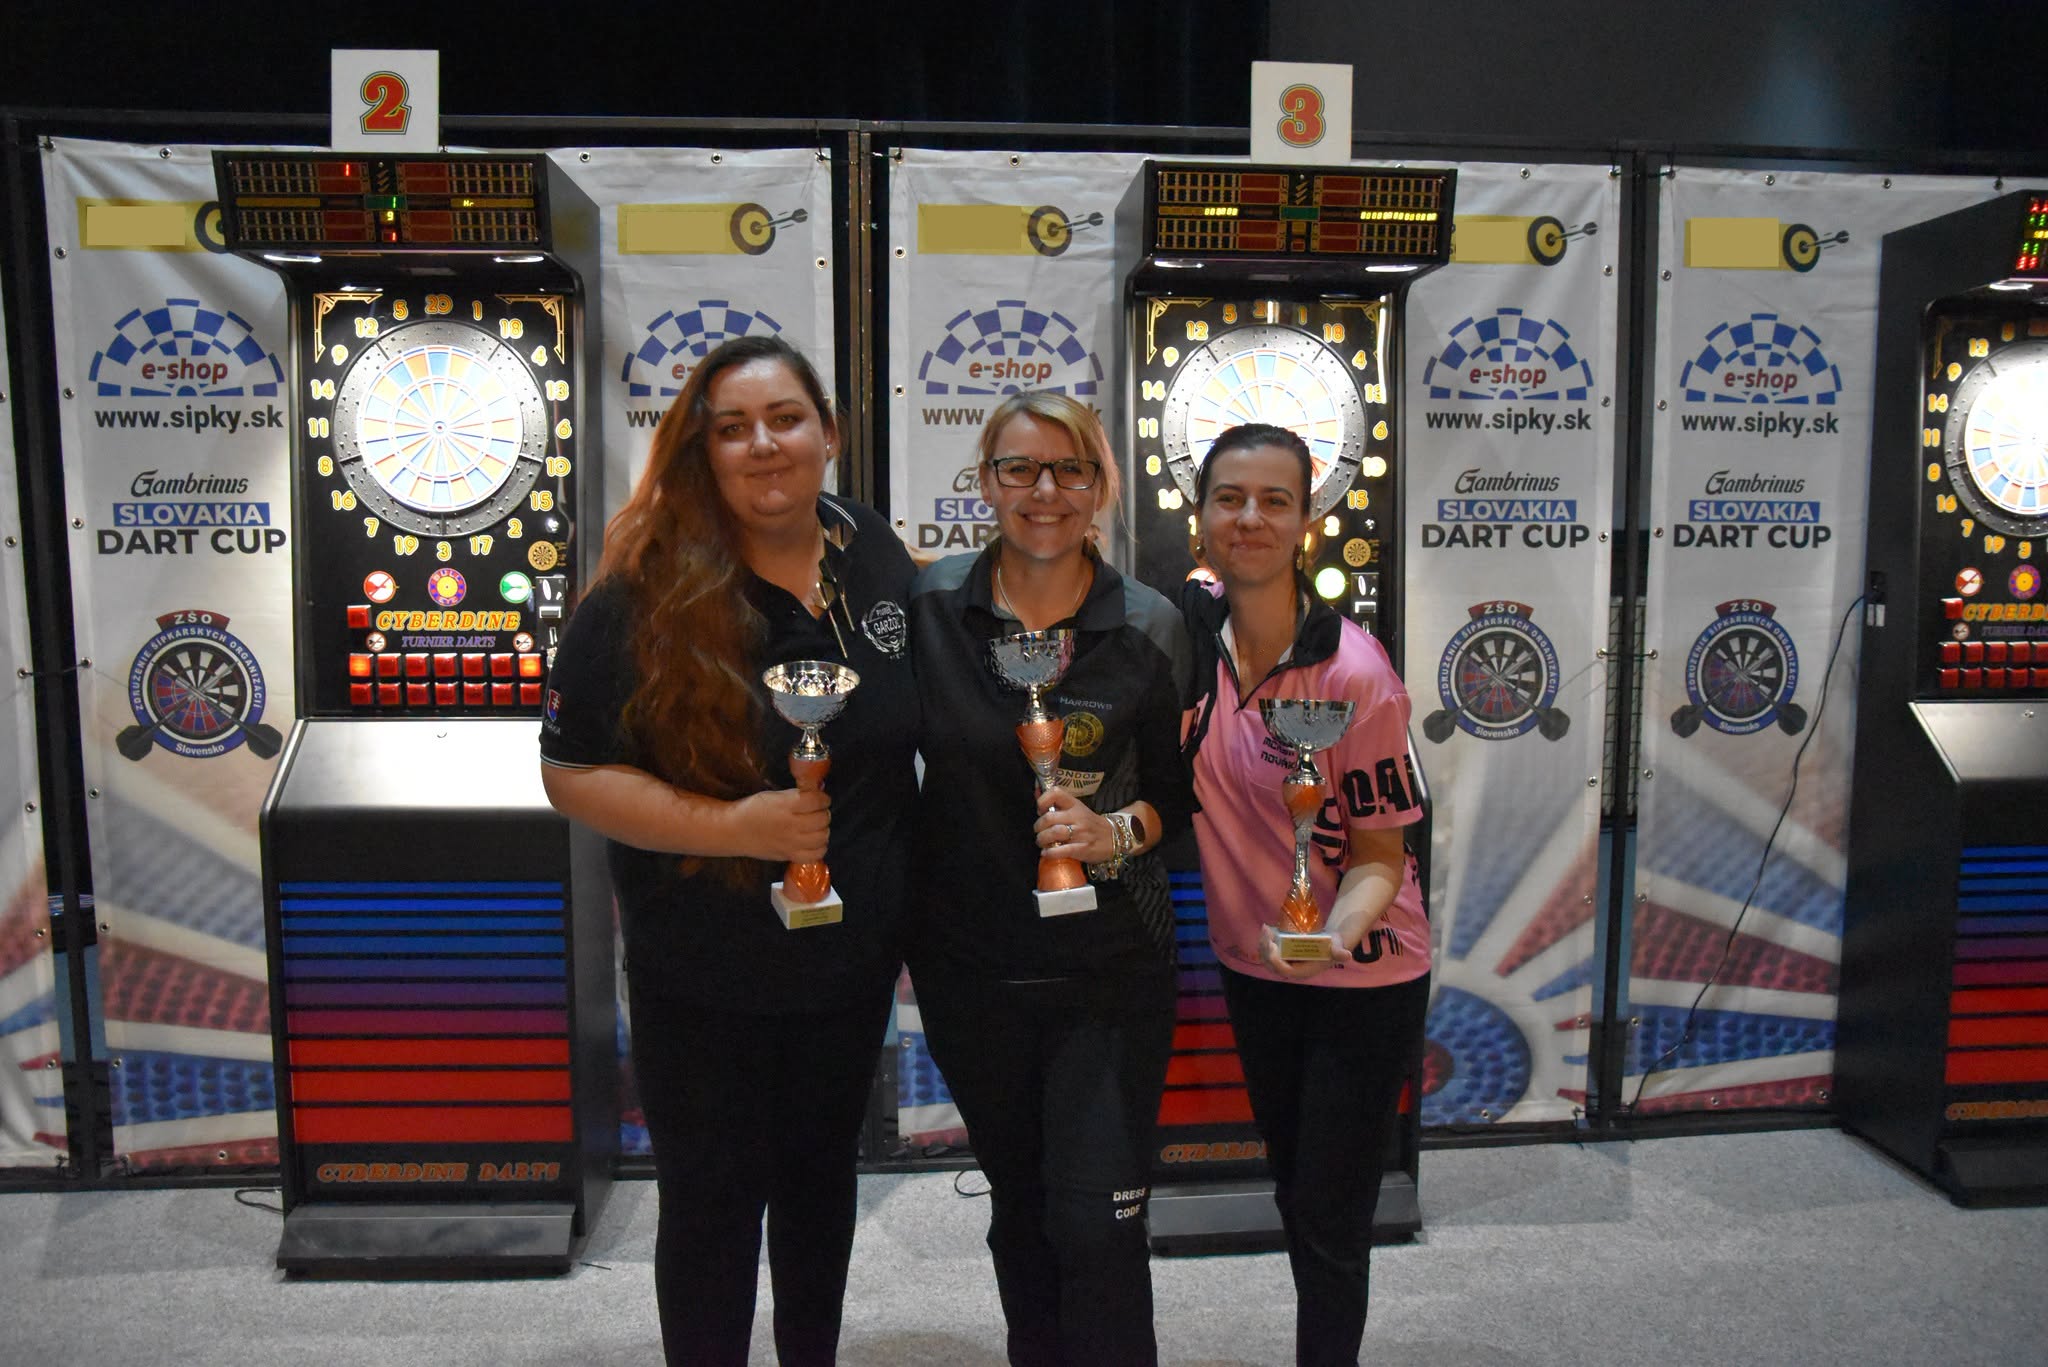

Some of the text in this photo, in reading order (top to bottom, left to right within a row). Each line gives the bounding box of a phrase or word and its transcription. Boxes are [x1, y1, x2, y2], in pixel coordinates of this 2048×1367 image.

[360, 70, 412, 135] 2
[1277, 84, 1326, 148] 3
[393, 300, 408, 320] 5
[425, 294, 453, 314] 20
[472, 300, 483, 321] 1
[1223, 303, 1238, 324] 5
[354, 317, 378, 338] 12
[499, 318, 523, 339] 18
[1186, 320, 1208, 341] 12
[1323, 323, 1345, 343] 18
[331, 344, 348, 366] 9
[531, 345, 548, 367] 4
[1968, 337, 1989, 357] 12
[1351, 350, 1367, 370] 4
[142, 358, 228, 384] e-shop
[969, 358, 1052, 384] e-shop
[1469, 364, 1547, 388] e-shop
[1724, 368, 1797, 393] e-shop
[310, 379, 336, 400] 14
[545, 380, 569, 401] 13
[1141, 380, 1166, 401] 14
[1928, 393, 1948, 413] 14
[95, 405, 284, 434] www.sipky.sk
[308, 418, 329, 438] 11
[556, 418, 572, 439] 6
[1138, 418, 1158, 438] 11
[1373, 420, 1388, 440] 6
[1426, 407, 1592, 435] www.sipky.sk
[1682, 411, 1839, 438] www.sipky.sk
[1923, 428, 1940, 447] 11
[318, 456, 333, 476] 8
[545, 456, 571, 477] 10
[131, 469, 249, 497] Gambrinus
[1455, 468, 1560, 494] Gambrinus
[1705, 470, 1805, 495] Gambrinus
[331, 490, 357, 511] 16
[530, 490, 553, 511] 15
[1347, 490, 1369, 510] 15
[1443, 501, 1571, 520] SLOVAKIA
[1936, 494, 1957, 513] 16
[119, 504, 264, 525] SLOVAKIA
[1694, 502, 1814, 521] SLOVAKIA
[363, 517, 379, 537] 7
[507, 518, 522, 538] 2
[1422, 524, 1590, 548] DART CUP
[1673, 524, 1831, 548] DART CUP
[1961, 518, 1975, 538] 7
[97, 528, 286, 555] DART CUP
[394, 535, 419, 555] 19
[436, 541, 452, 561] 3
[469, 535, 493, 555] 17
[1984, 535, 2005, 554] 19
[174, 611, 212, 624] ZŠO
[376, 610, 521, 631] CYBERDINE
[401, 635, 496, 648] TURNIER DARTS
[1475, 727, 1519, 738] Slovensko
[175, 742, 225, 756] Slovensko
